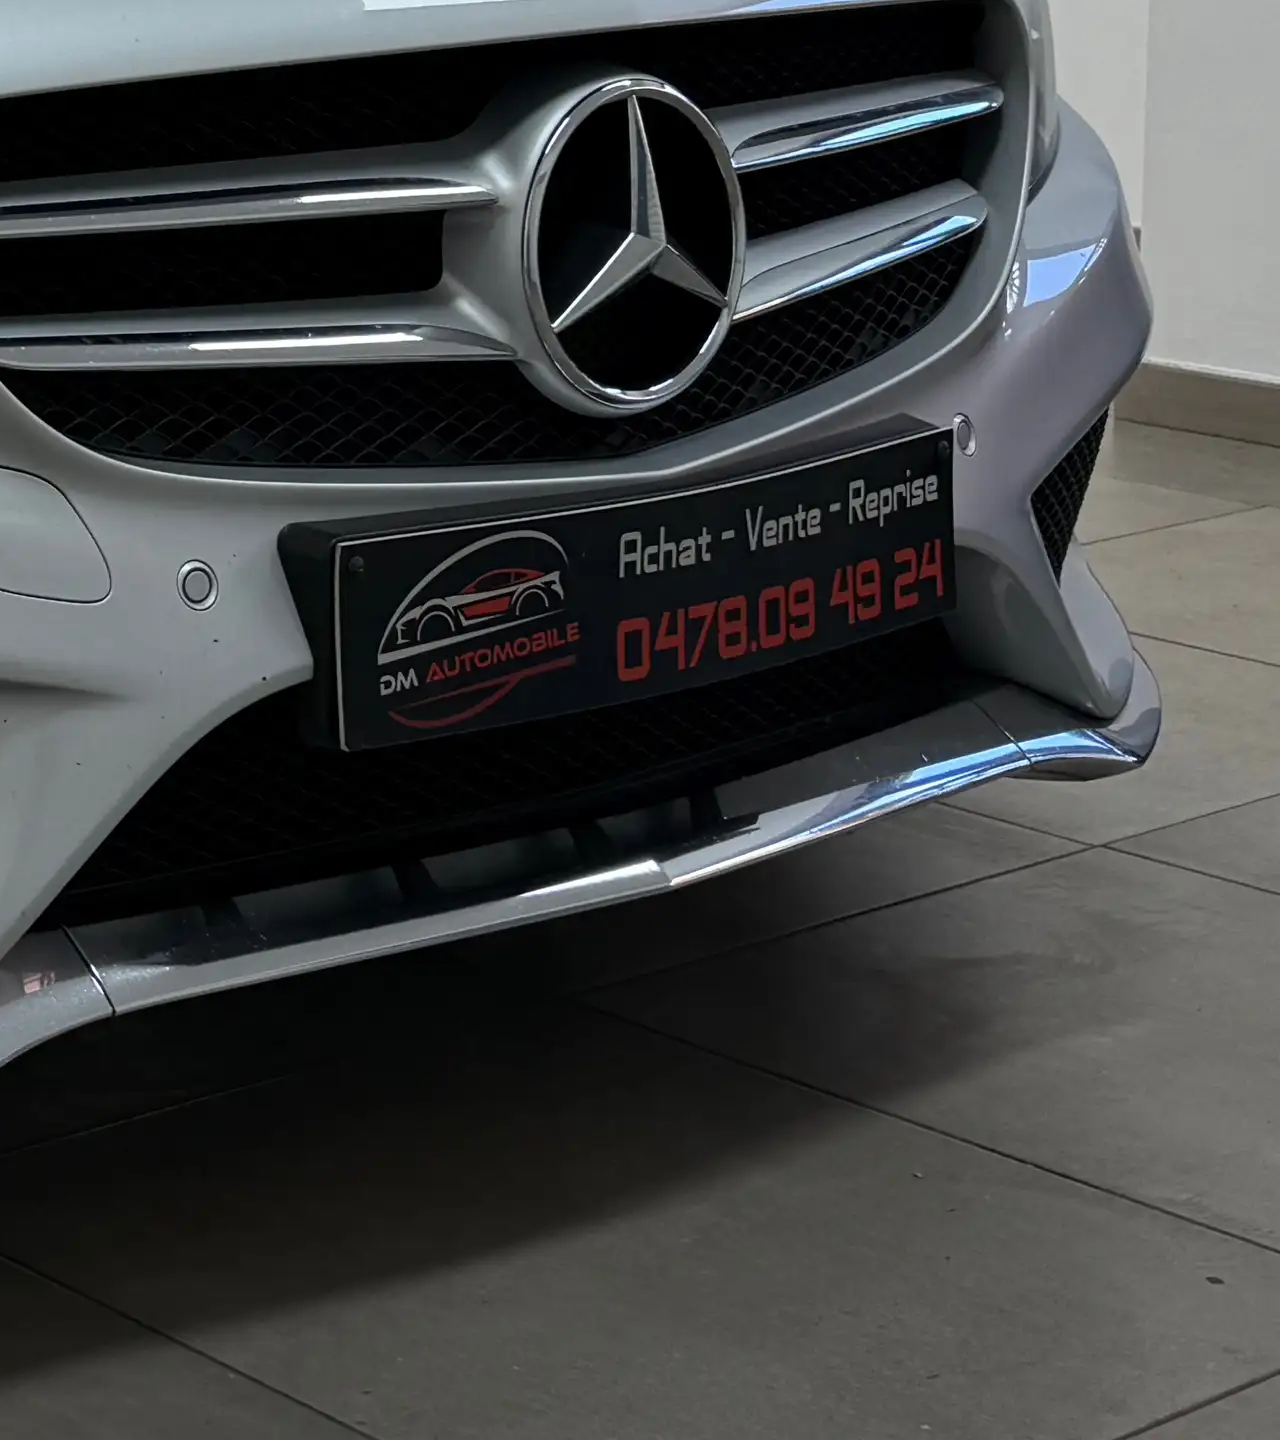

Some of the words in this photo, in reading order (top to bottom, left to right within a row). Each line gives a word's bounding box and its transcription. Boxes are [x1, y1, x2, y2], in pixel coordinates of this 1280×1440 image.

[618, 526, 712, 578] Achat
[721, 529, 735, 541] -
[745, 505, 821, 551] Vente
[829, 501, 842, 513] -
[848, 470, 939, 527] Reprise
[380, 668, 419, 696] DM
[426, 622, 580, 683] AUTOMOBILE
[616, 577, 815, 682] 0478.09
[830, 558, 882, 624] 49
[894, 538, 944, 611] 24
